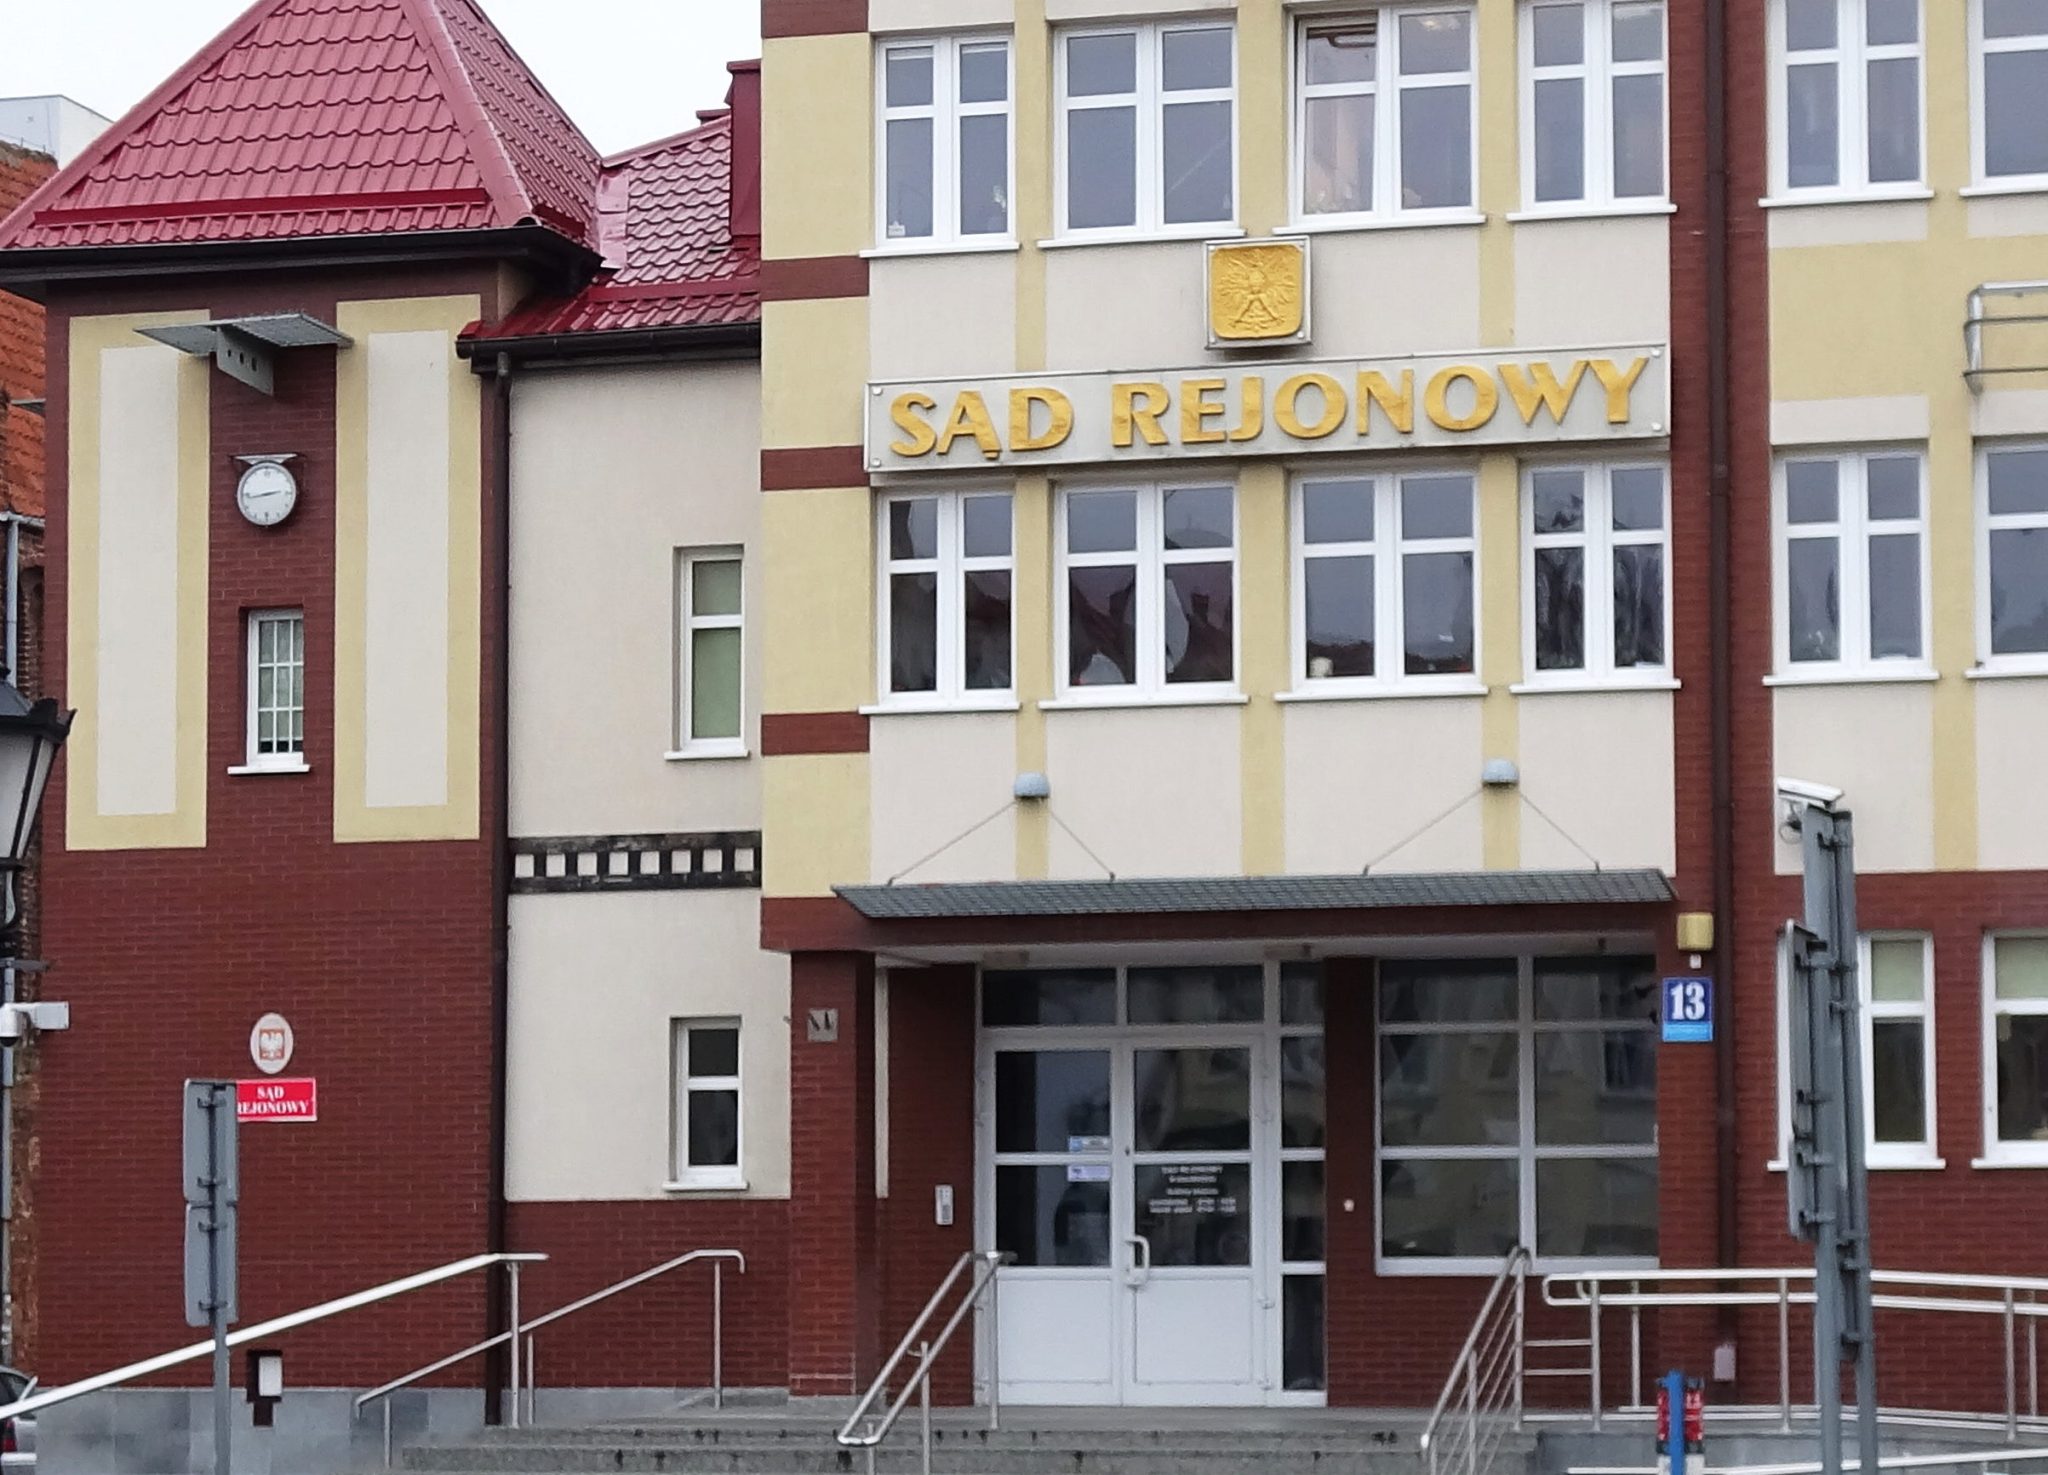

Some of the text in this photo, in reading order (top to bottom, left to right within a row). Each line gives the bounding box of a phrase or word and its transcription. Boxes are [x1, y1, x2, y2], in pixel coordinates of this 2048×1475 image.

[889, 357, 1650, 460] SĄD REJONOWY
[1670, 981, 1706, 1020] 13
